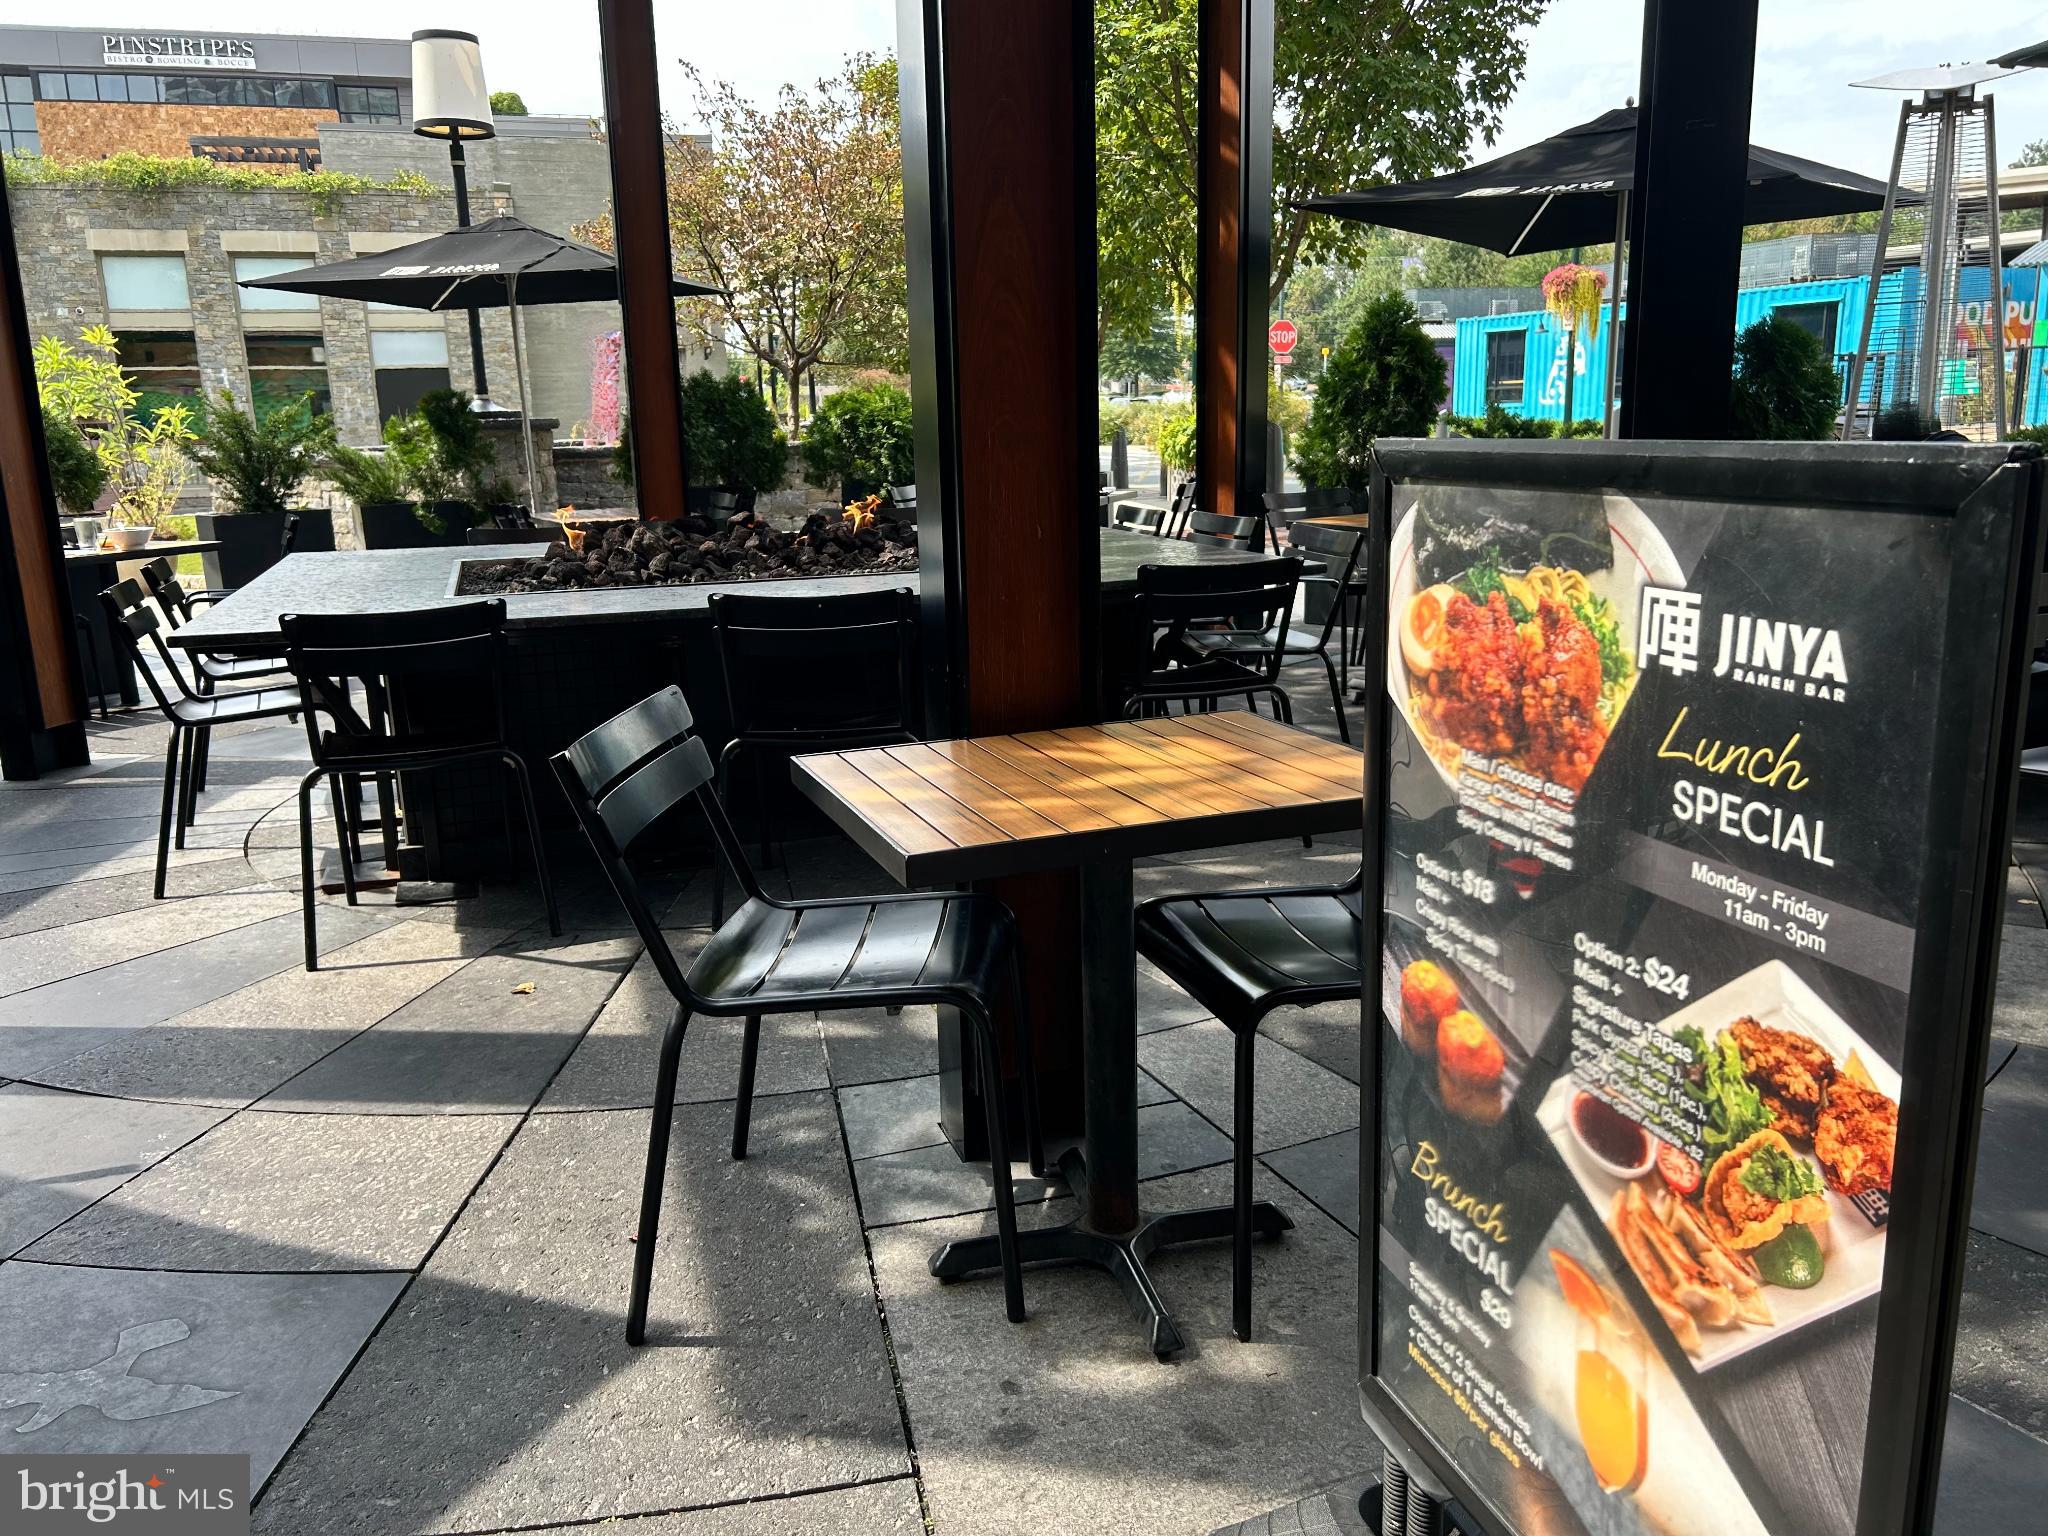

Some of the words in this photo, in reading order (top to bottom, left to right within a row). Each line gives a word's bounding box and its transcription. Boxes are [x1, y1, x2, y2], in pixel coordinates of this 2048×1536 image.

[102, 35, 254, 58] PINSTRIPES
[106, 55, 143, 63] BISTRO
[157, 57, 200, 65] BOWLING
[217, 59, 250, 67] BOCCE
[1270, 330, 1296, 344] STOP
[1713, 613, 1849, 684] JINYA
[1732, 668, 1796, 692] RAMEN
[1804, 681, 1847, 703] BAR
[1657, 706, 1810, 791] Lunch
[1671, 779, 1835, 868] SPECIAL
[1416, 852, 1450, 882] Option
[1461, 868, 1496, 904] $18
[1416, 874, 1442, 902] Main
[1690, 860, 1759, 904] Monday
[1771, 889, 1830, 931] Friday
[1723, 898, 1770, 931] 11am
[1784, 921, 1827, 954] 3pm
[1573, 932, 1625, 972] Option
[1624, 956, 1642, 979] 2:
[1642, 955, 1691, 1001] $24
[1573, 957, 1611, 992] Main
[1572, 984, 1643, 1036] Signature
[1643, 1020, 1694, 1064] Tapas
[1608, 1072, 1660, 1114] Chicken
[1636, 1065, 1668, 1096] Taco
[1411, 1140, 1509, 1244] Brunch
[1424, 1196, 1515, 1297] SPECIAL
[1456, 1305, 1493, 1349] Sunday
[1480, 1288, 1513, 1330] $29
[1408, 1304, 1443, 1346] Choice
[1443, 1340, 1457, 1358] of
[1456, 1350, 1465, 1368] 2
[1464, 1358, 1495, 1398] Small
[1495, 1389, 1532, 1437] Plates
[1416, 1332, 1451, 1375] Choice
[1451, 1370, 1466, 1388] of
[1473, 1388, 1513, 1438] Ramen
[1512, 1428, 1545, 1471] Bowl
